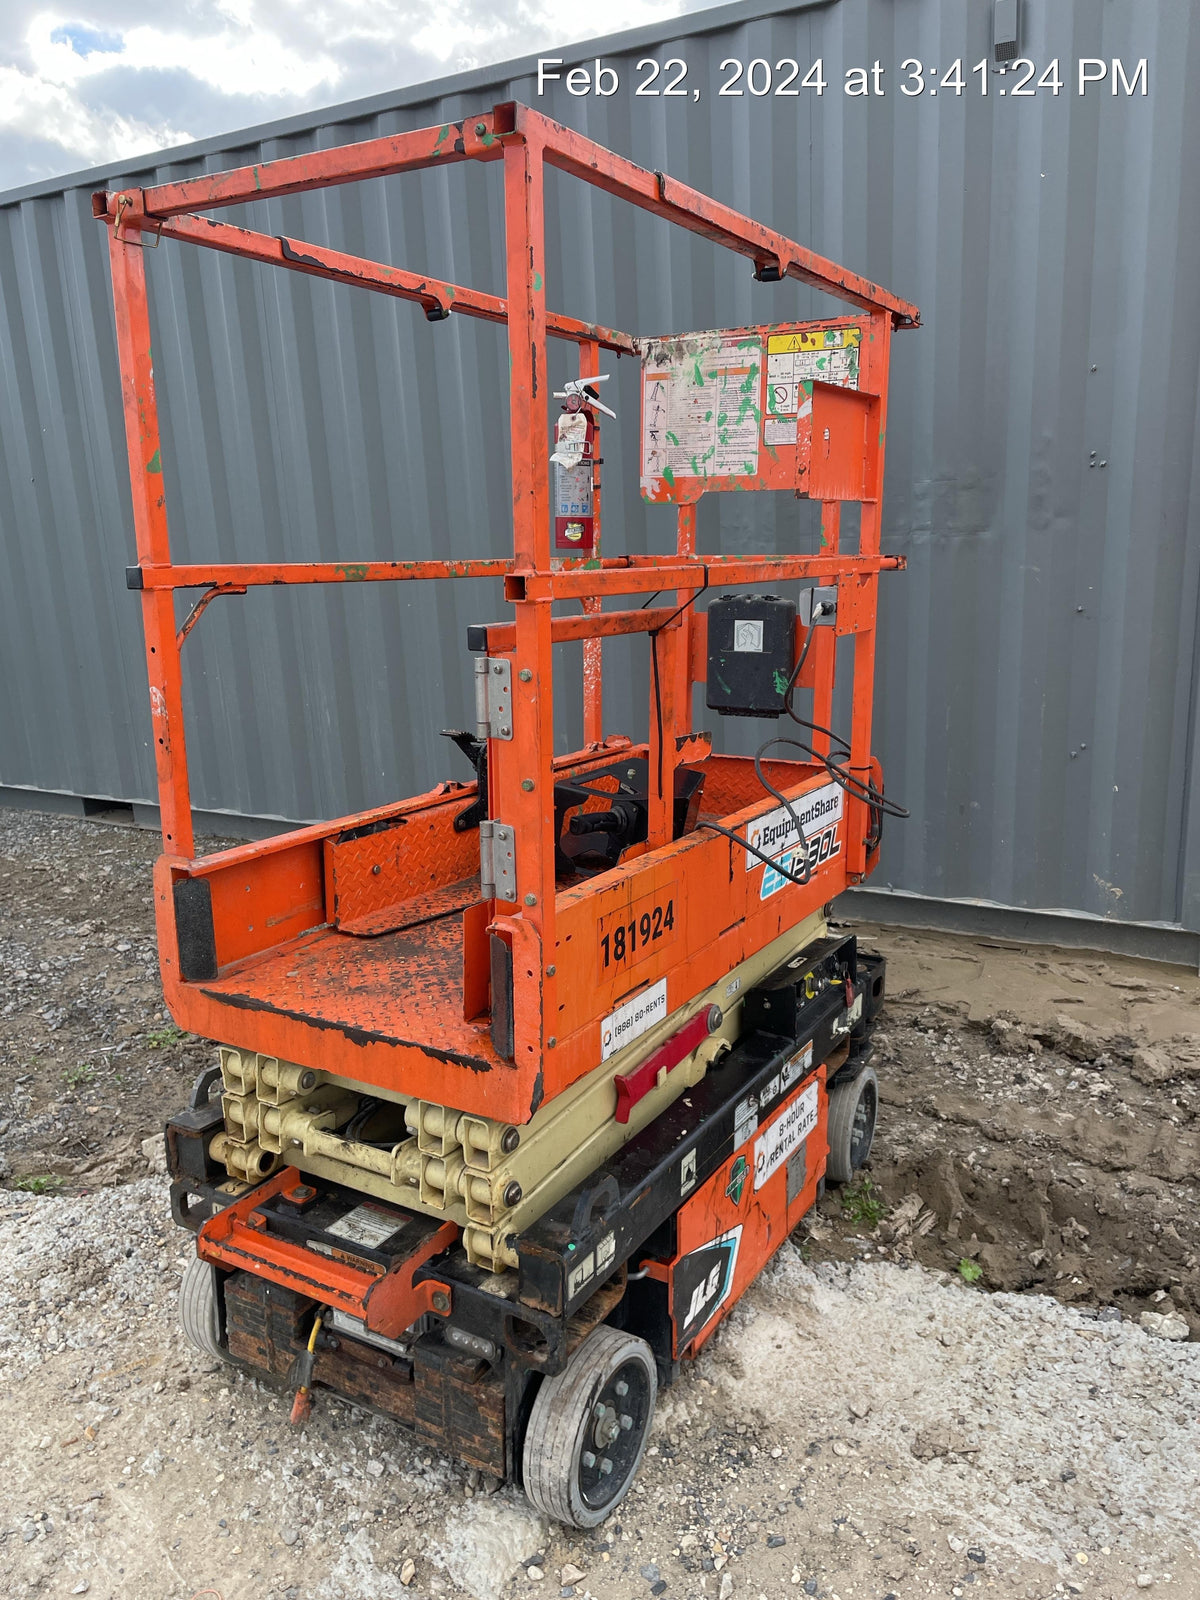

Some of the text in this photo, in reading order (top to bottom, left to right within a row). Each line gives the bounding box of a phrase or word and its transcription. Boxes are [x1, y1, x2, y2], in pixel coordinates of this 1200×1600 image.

[600, 899, 675, 968] 181924
[614, 994, 666, 1038] (888) 80-RENTS
[770, 1130, 796, 1166] RENTAL
[797, 1109, 815, 1137] RATE
[779, 1102, 805, 1137] 8-HOUR
[682, 1258, 722, 1331] JLG
